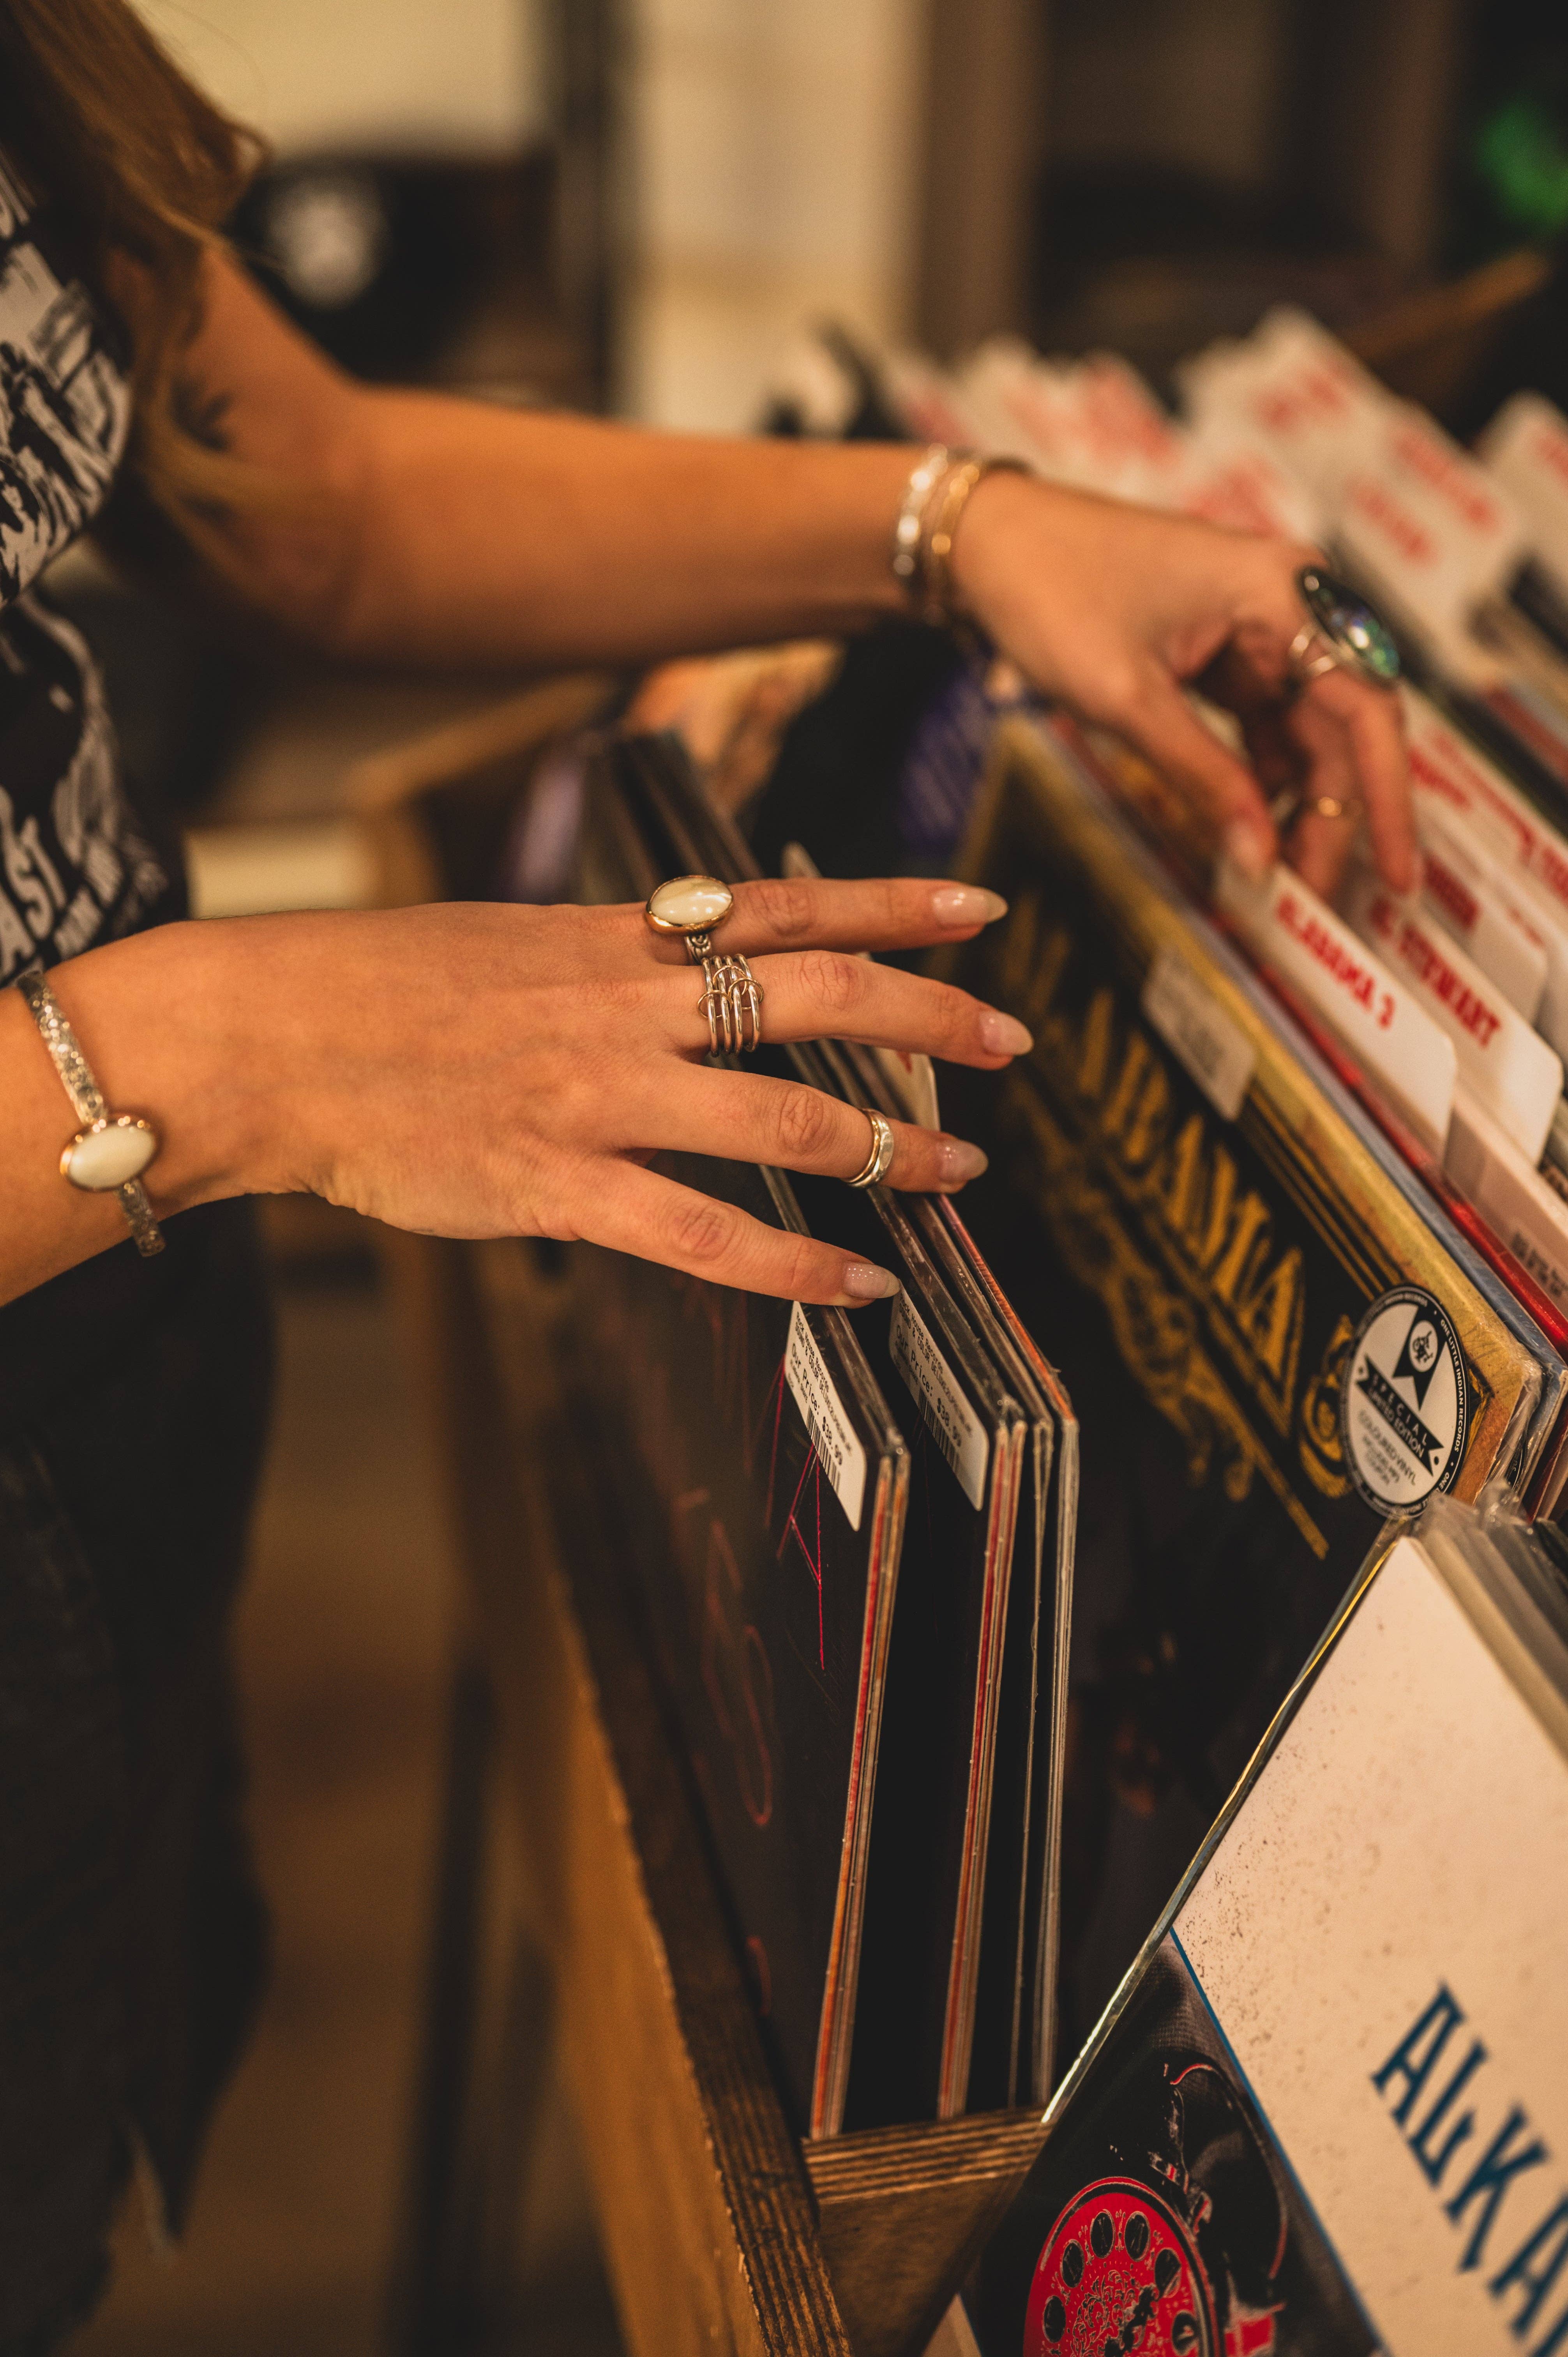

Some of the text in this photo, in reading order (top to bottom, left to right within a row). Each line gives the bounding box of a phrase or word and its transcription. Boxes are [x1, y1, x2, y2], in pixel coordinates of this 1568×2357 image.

[795, 1322, 805, 1348] SOUND
[809, 1355, 819, 1382] COLOR
[805, 1332, 815, 1358] House
[816, 1357, 829, 1392] Records
[899, 1303, 911, 1329] SOUND
[917, 1336, 930, 1363] COLOR
[912, 1313, 923, 1340] House
[926, 1339, 943, 1373] Records
[792, 1343, 842, 1465] Our Price: $38.99
[897, 1324, 908, 1350] Our
[911, 1350, 932, 1397] Price:
[937, 1398, 961, 1447] $38.99
[1373, 1373, 1427, 1446] SPECIAL
[1441, 1319, 1450, 1336] ONE
[1449, 1336, 1459, 1366] LITTLE
[1454, 1407, 1464, 1452] RECORDS
[1394, 1417, 1425, 1458] EDITION
[1370, 1975, 1568, 2357] ALKA
